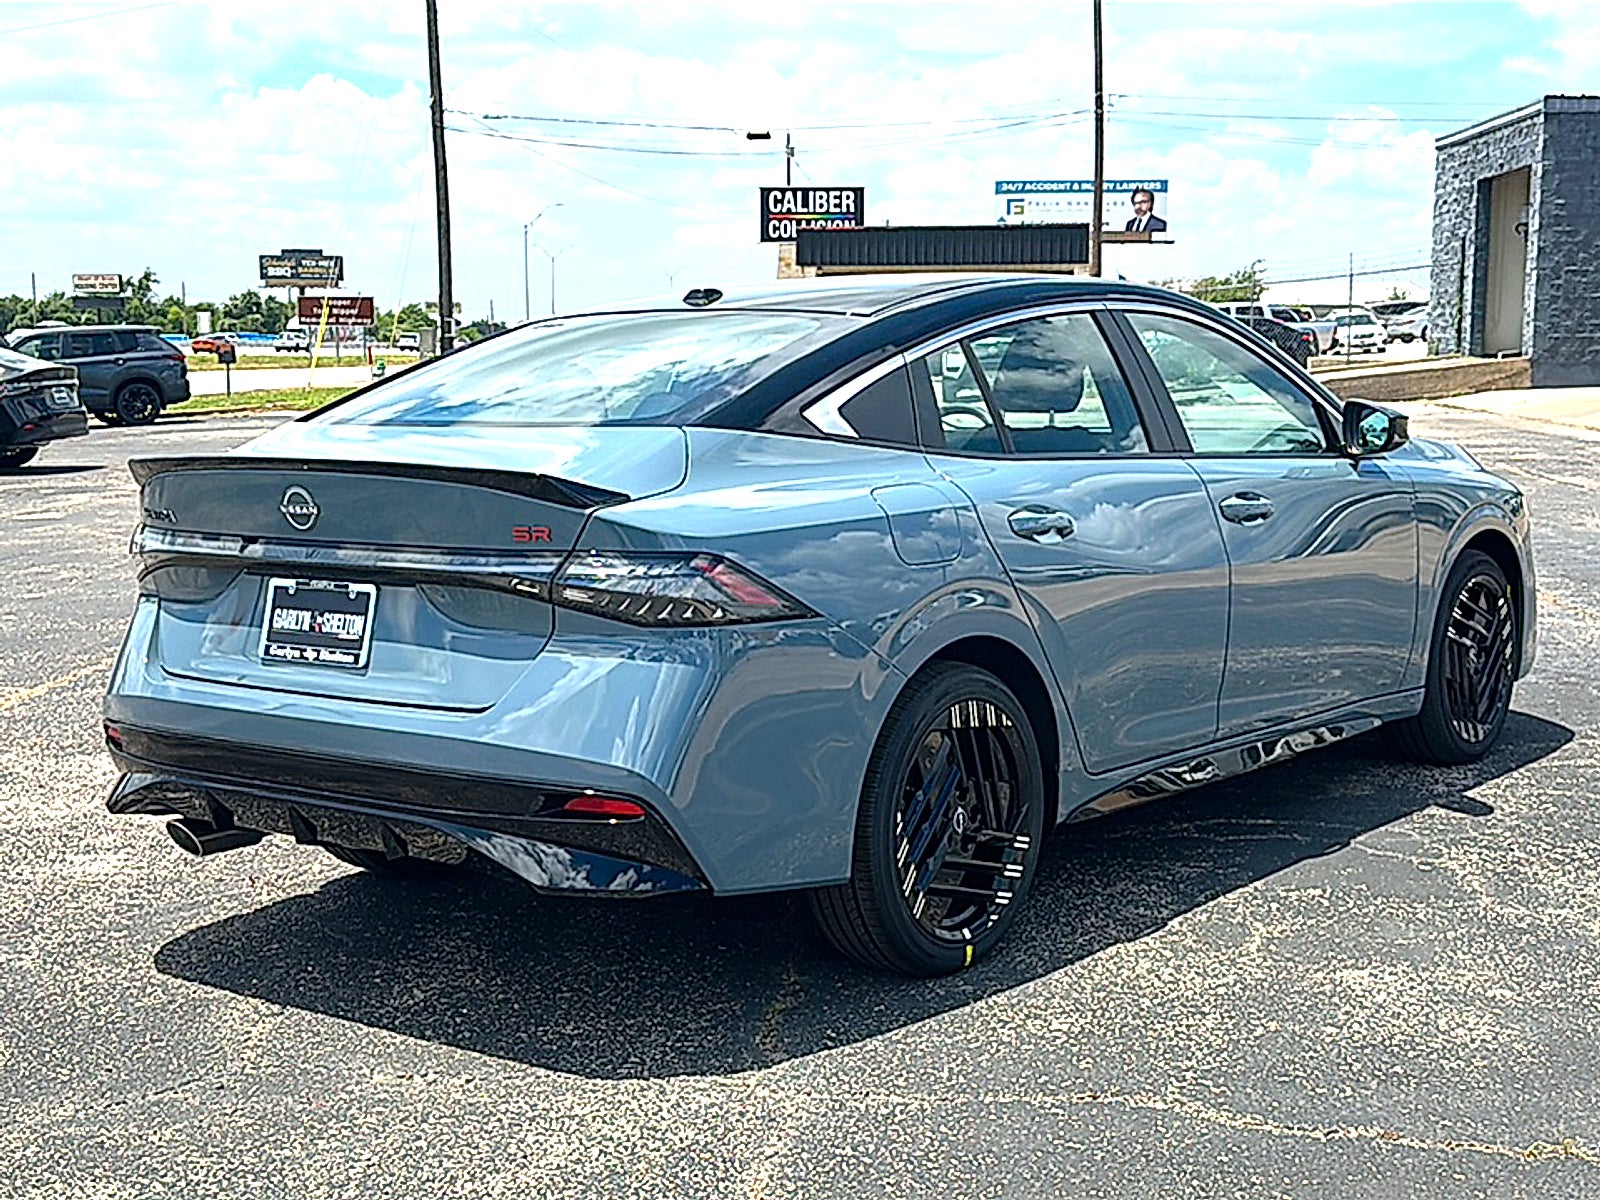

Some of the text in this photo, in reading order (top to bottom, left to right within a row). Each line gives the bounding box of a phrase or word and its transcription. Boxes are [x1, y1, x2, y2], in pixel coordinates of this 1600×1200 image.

[1001, 182, 1023, 191] 24/7
[1024, 182, 1071, 191] ACCIDENT
[1081, 182, 1114, 191] INJRY
[1116, 181, 1161, 191] LAWYERS
[768, 190, 855, 213] CALIBER
[280, 503, 318, 515] NISSAN
[512, 526, 552, 542] SR
[273, 608, 366, 636] GARLYN SHELTON
